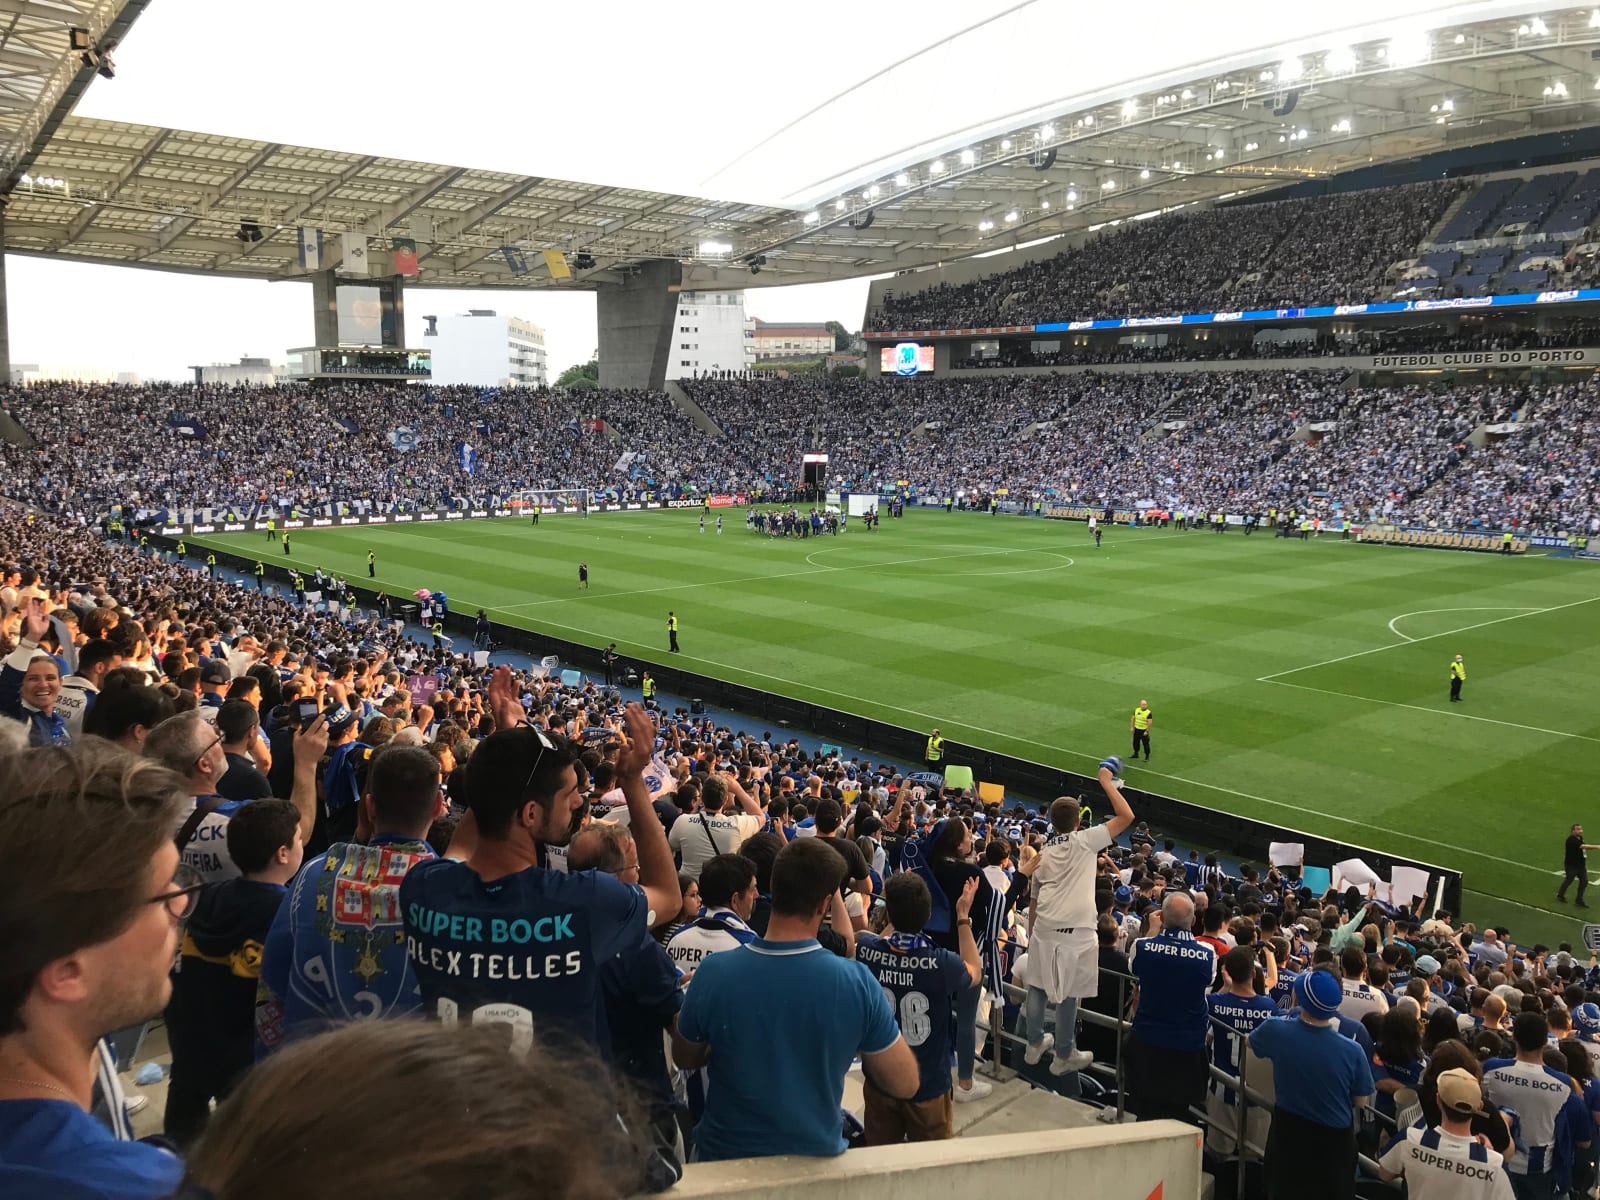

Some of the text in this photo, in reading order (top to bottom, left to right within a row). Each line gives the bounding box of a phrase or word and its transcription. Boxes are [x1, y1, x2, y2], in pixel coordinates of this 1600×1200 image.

[1373, 350, 1585, 367] FUTEBOL CLUBE DO PORTO
[193, 523, 214, 533] bwin
[224, 522, 245, 532] bwin
[254, 521, 267, 530] bw
[409, 902, 576, 944] SUPER BOCK
[407, 935, 581, 980] ALEX TELLES
[667, 947, 702, 963] SUPER
[859, 946, 938, 970] SUPER BOCK
[1144, 942, 1209, 961] SUPER BOCK
[879, 969, 914, 987] ARTUR
[1352, 992, 1376, 1001] BOCK
[1214, 1005, 1272, 1020] SUPER BOCK
[1234, 1019, 1254, 1030] DIAS
[1494, 1071, 1563, 1092] SUPER BOCK
[1411, 1147, 1494, 1182] SUPER BOCK
